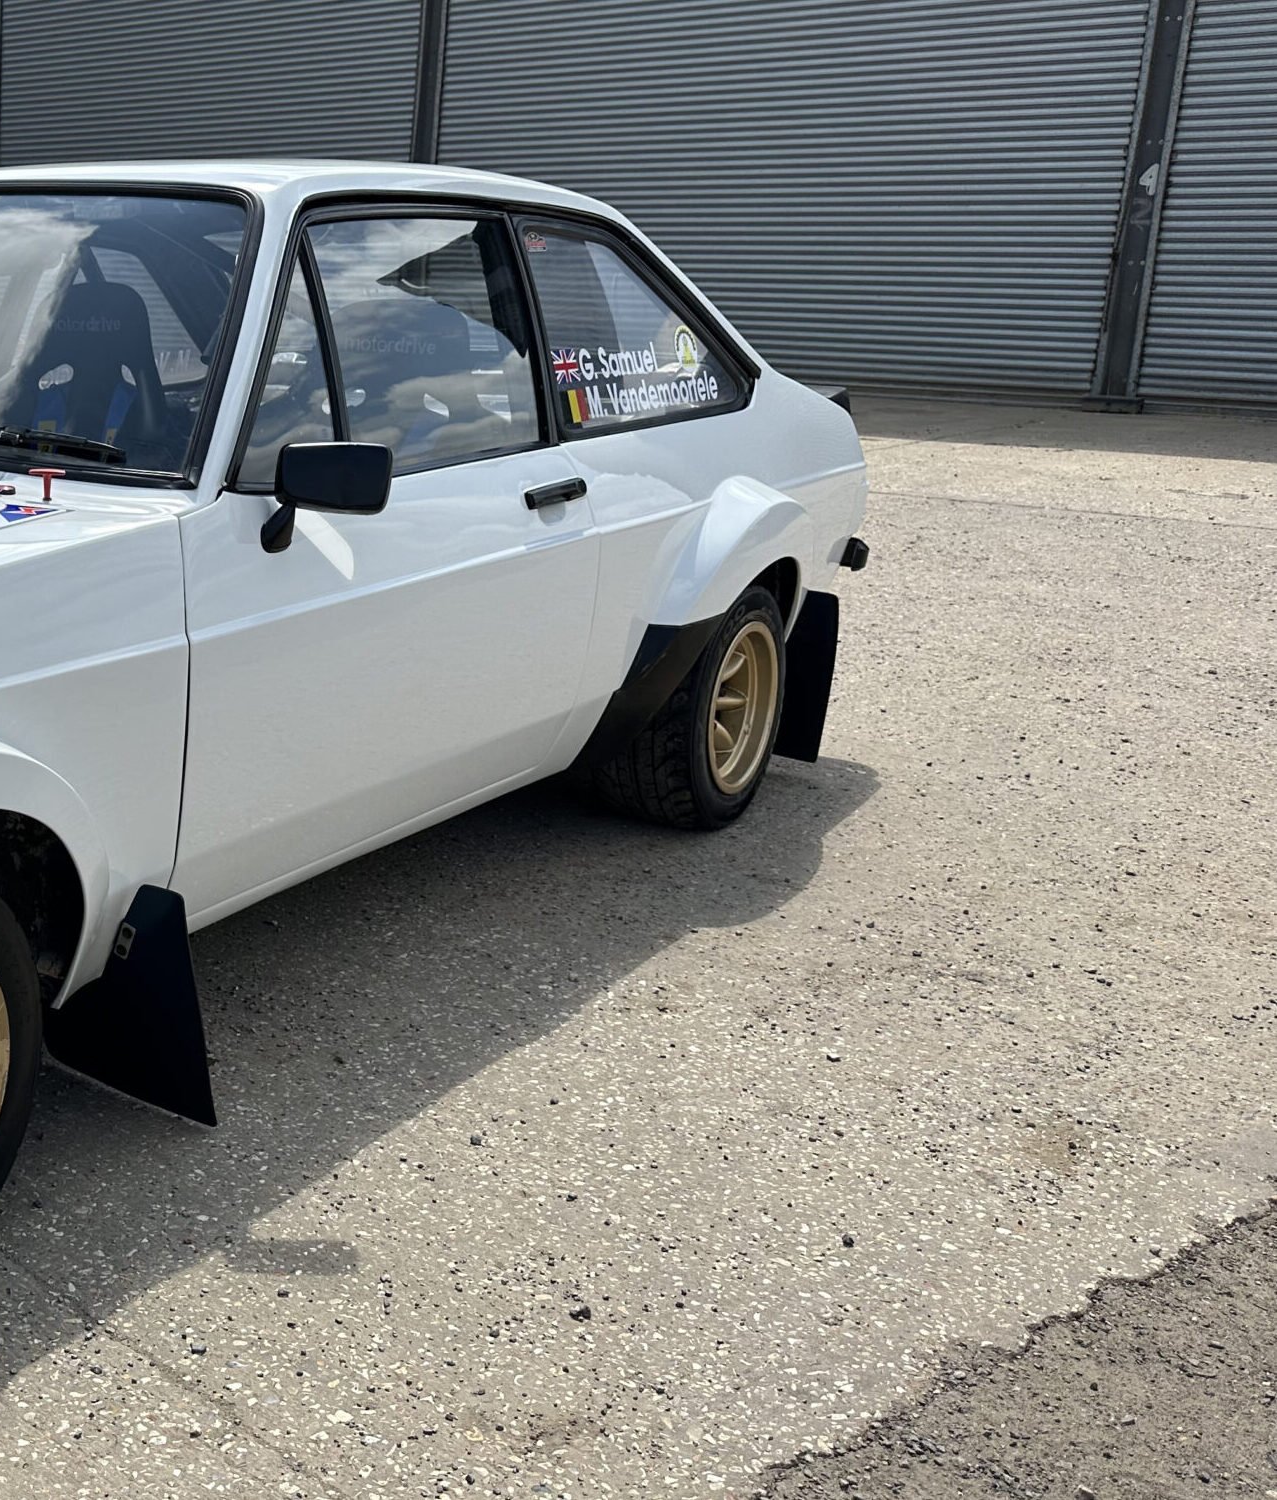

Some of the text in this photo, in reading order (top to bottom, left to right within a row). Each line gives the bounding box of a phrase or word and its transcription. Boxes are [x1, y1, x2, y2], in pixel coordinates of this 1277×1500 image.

[49, 315, 121, 333] otordrive
[344, 335, 436, 356] motordrive
[578, 341, 659, 381] G. Samuel
[585, 370, 719, 419] M. Vandemoortele
